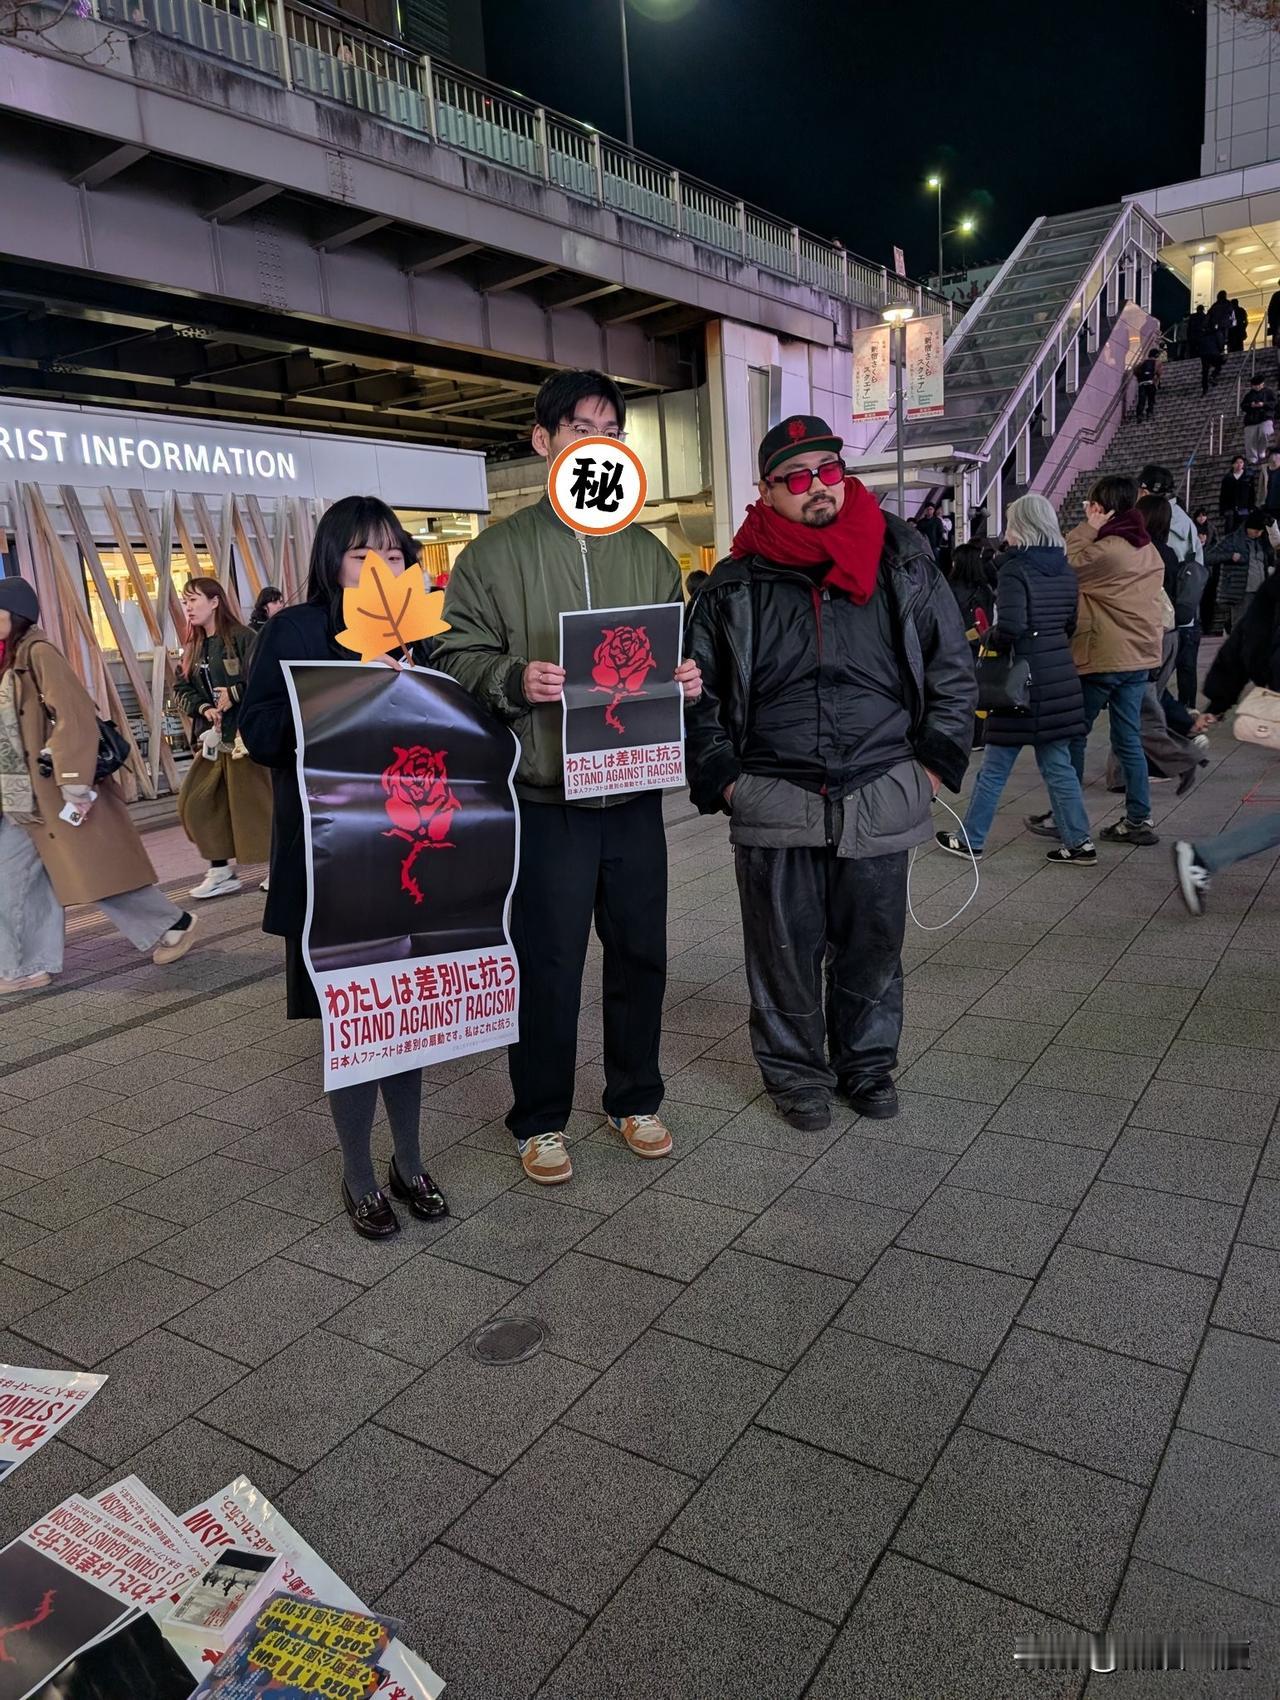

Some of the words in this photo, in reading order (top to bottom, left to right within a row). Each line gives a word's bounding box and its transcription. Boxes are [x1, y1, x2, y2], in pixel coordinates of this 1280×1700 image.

[81, 433, 297, 480] INFORMATION
[566, 745, 681, 773] わたしは差別に抗う
[567, 774, 571, 788] I
[573, 771, 603, 787] STAND
[606, 766, 645, 782] AGAINST
[647, 762, 682, 778] RACISM
[325, 956, 516, 1018] わたしは差別に抗う
[329, 1022, 336, 1052] I
[340, 1012, 395, 1050] STAND
[399, 998, 463, 1037] AGAINST
[466, 988, 516, 1022] RACISM
[53, 1404, 77, 1424] I
[47, 1507, 94, 1538] RACISM
[82, 1529, 131, 1561] AGAINST
[28, 1524, 152, 1600] わたしは差別に抗う
[124, 1553, 166, 1580] STAND
[156, 1570, 172, 1584] I
[280, 1601, 310, 1621] 15:00
[252, 1648, 282, 1668] SUN
[273, 1635, 302, 1657] 15:00
[332, 1634, 372, 1655] 2026
[277, 1659, 321, 1689] 1.11
